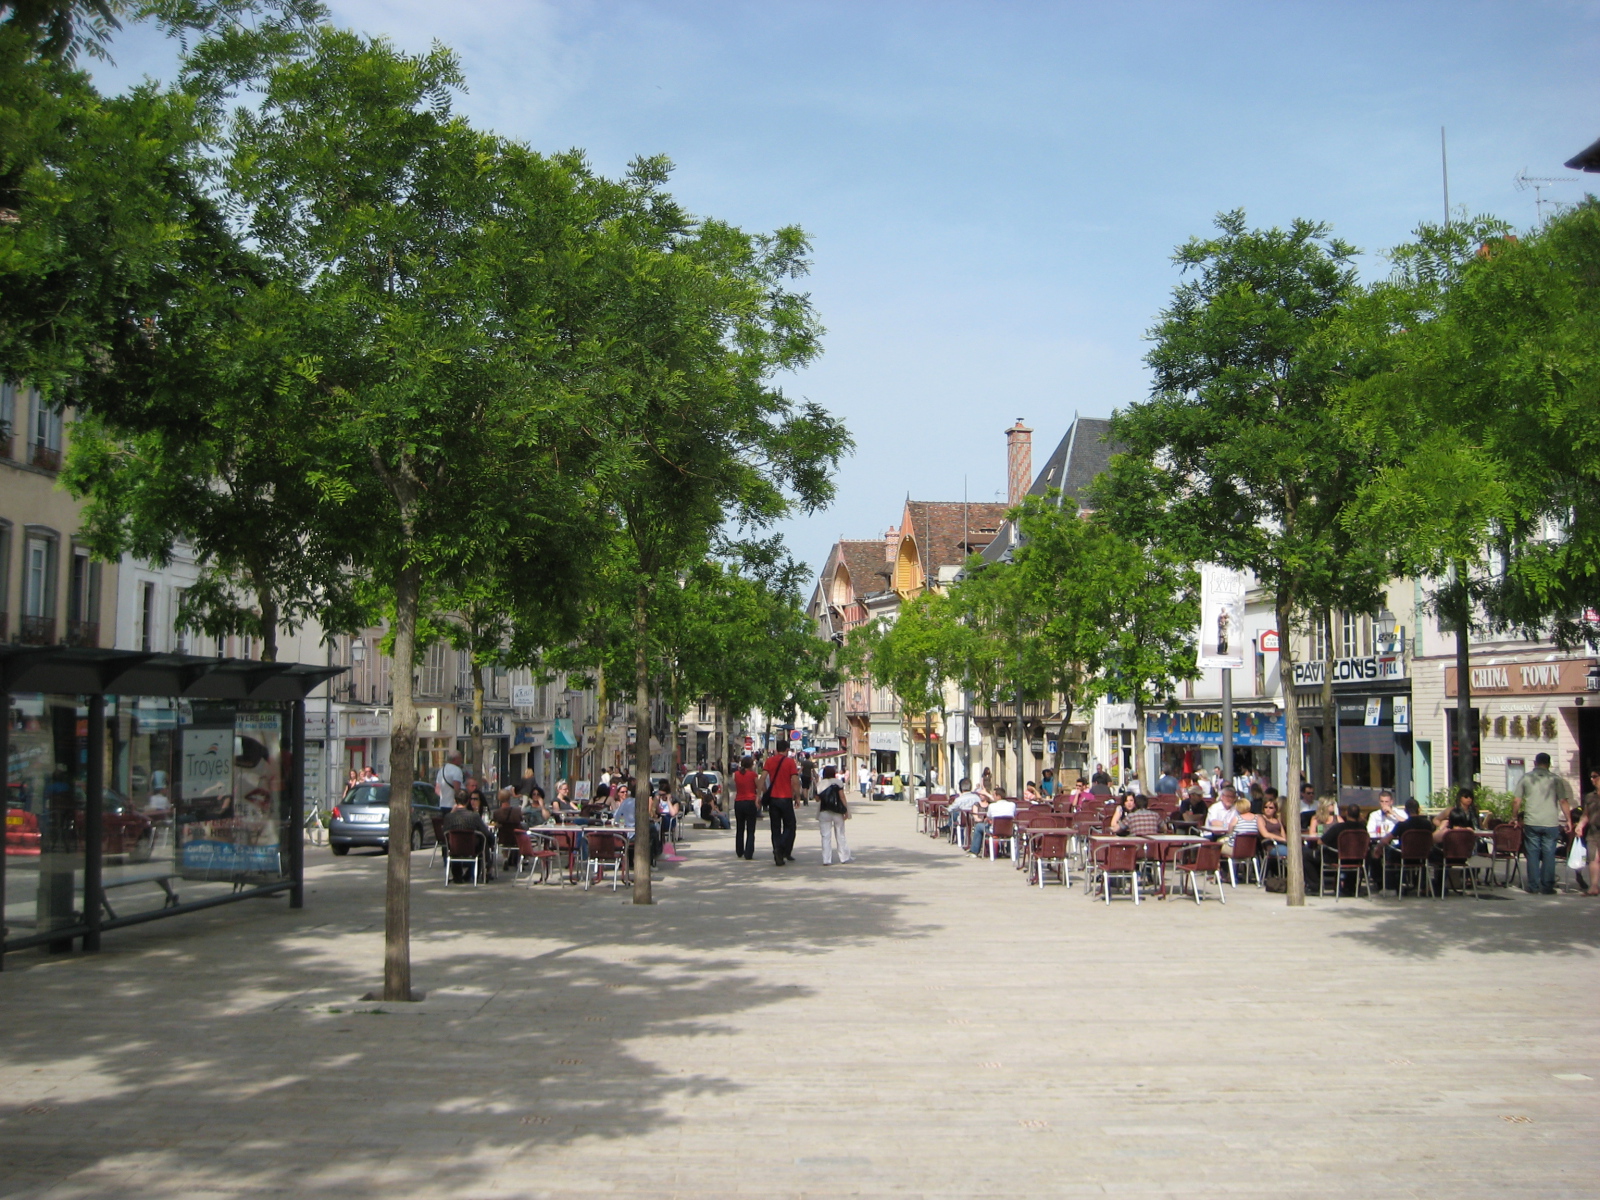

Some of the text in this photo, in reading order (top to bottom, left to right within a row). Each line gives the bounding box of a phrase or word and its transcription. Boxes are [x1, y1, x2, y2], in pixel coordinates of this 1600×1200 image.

[1296, 658, 1376, 682] PAVILONS
[1471, 664, 1560, 688] CHINA TOWN
[1367, 706, 1378, 716] gan
[1394, 705, 1406, 715] gan
[1180, 714, 1191, 732] LA
[186, 753, 229, 780] Troyes
